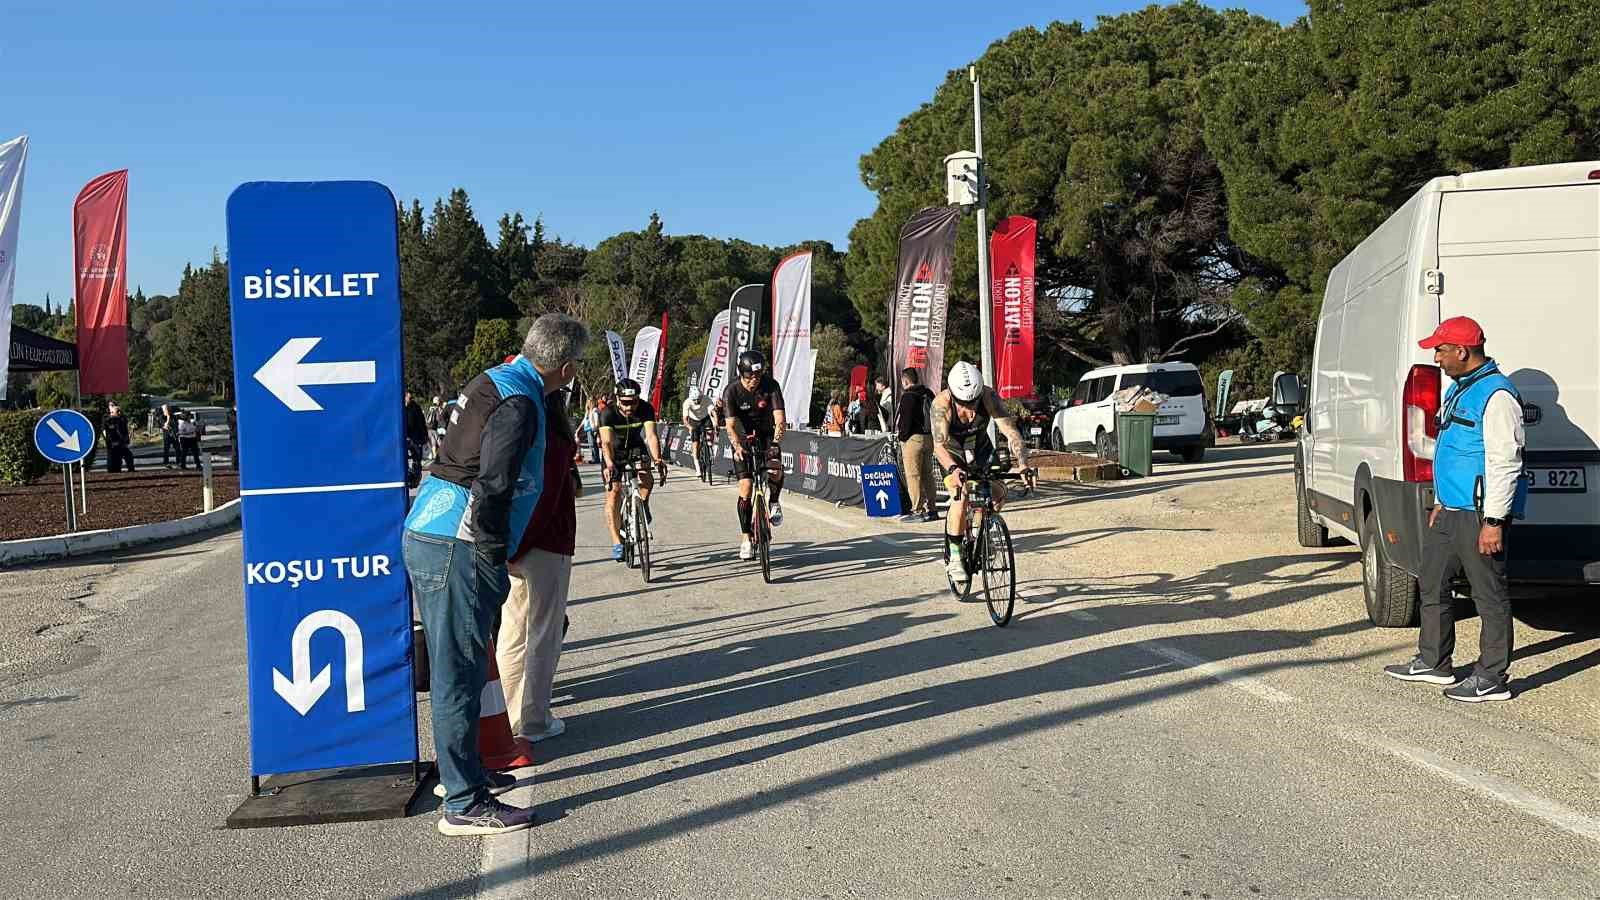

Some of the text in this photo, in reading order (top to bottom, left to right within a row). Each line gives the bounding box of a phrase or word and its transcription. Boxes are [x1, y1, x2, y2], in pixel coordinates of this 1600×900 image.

[244, 268, 380, 299] BİSİKLET
[736, 306, 750, 352] chi
[869, 479, 891, 487] ALANI
[1548, 470, 1580, 487] 822
[247, 554, 391, 588] KOŞU TUR
